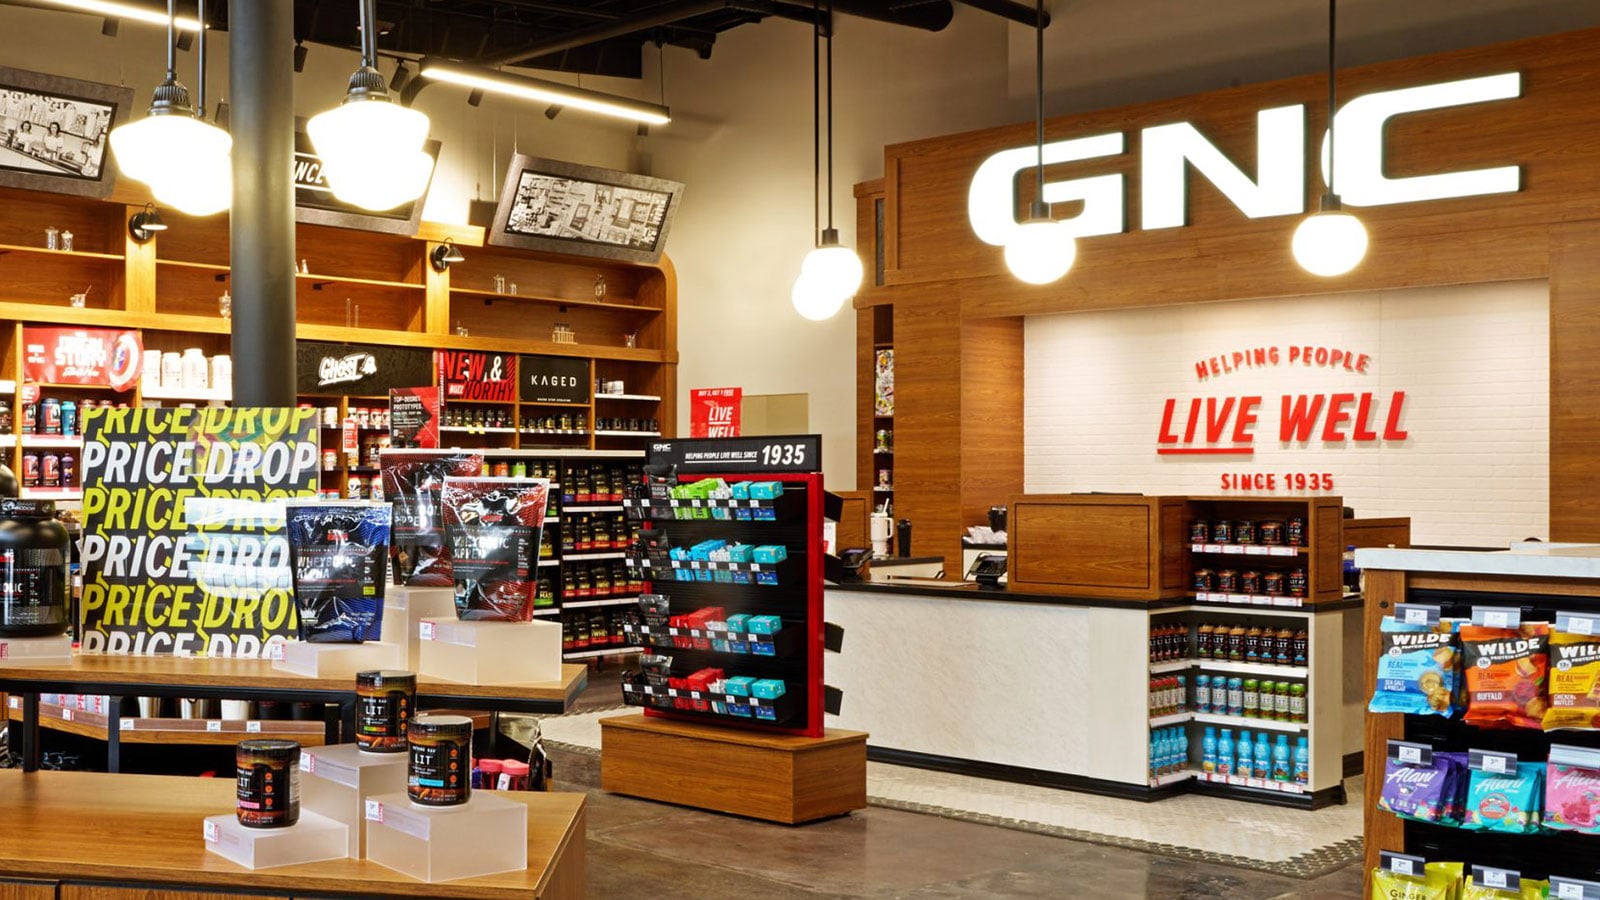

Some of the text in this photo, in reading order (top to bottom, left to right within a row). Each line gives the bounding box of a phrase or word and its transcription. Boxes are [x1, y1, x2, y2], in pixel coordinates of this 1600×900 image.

[968, 72, 1522, 247] GNC
[445, 352, 502, 382] NEW &
[1195, 346, 1370, 381] HELPING PEOPLE
[531, 375, 577, 387] KAGED
[82, 408, 317, 434] PRICE DROP
[709, 406, 733, 421] LIVE
[1158, 391, 1408, 443] LIVE WELL
[82, 441, 317, 485] PRICE DROP
[731, 451, 743, 459] WELL
[762, 444, 806, 465] 1935
[1221, 473, 1334, 491] SINCE 1935
[82, 488, 317, 532] PRICE DRO
[82, 535, 197, 578] PRICE
[81, 584, 196, 627] PRICE
[81, 631, 196, 657] PRICE
[1392, 634, 1452, 646] WILDE
[1477, 638, 1541, 656] WILDE
[1556, 674, 1574, 683] REAL
[1477, 692, 1503, 701] BUFFALO
[365, 705, 383, 715] LIT
[415, 753, 431, 765] LIT
[1386, 767, 1439, 784] Alani
[1474, 775, 1528, 795] Alani
